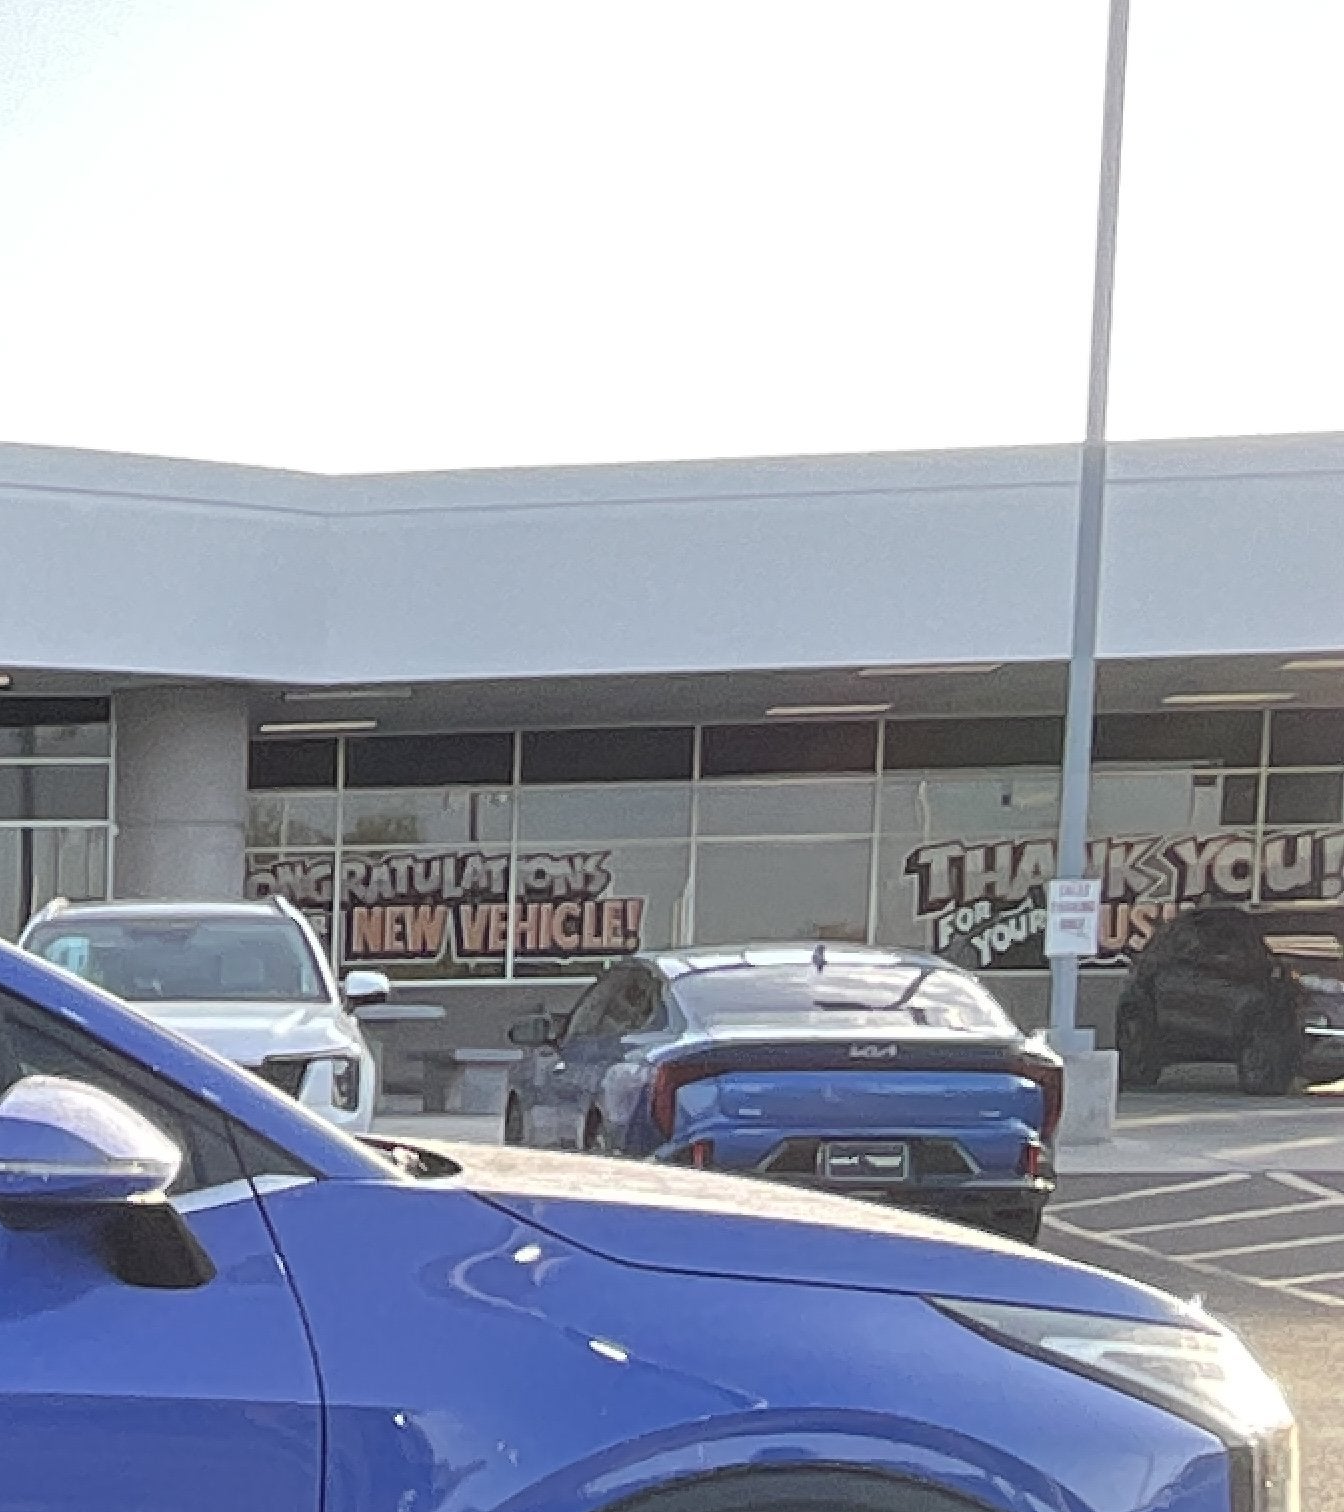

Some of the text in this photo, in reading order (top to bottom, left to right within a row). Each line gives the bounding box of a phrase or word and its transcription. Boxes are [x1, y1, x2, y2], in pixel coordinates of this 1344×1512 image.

[246, 852, 612, 903] ONGRATULATIONS
[351, 904, 449, 953] NEW
[457, 900, 644, 953] VEHICLE!
[938, 900, 992, 950] FOR
